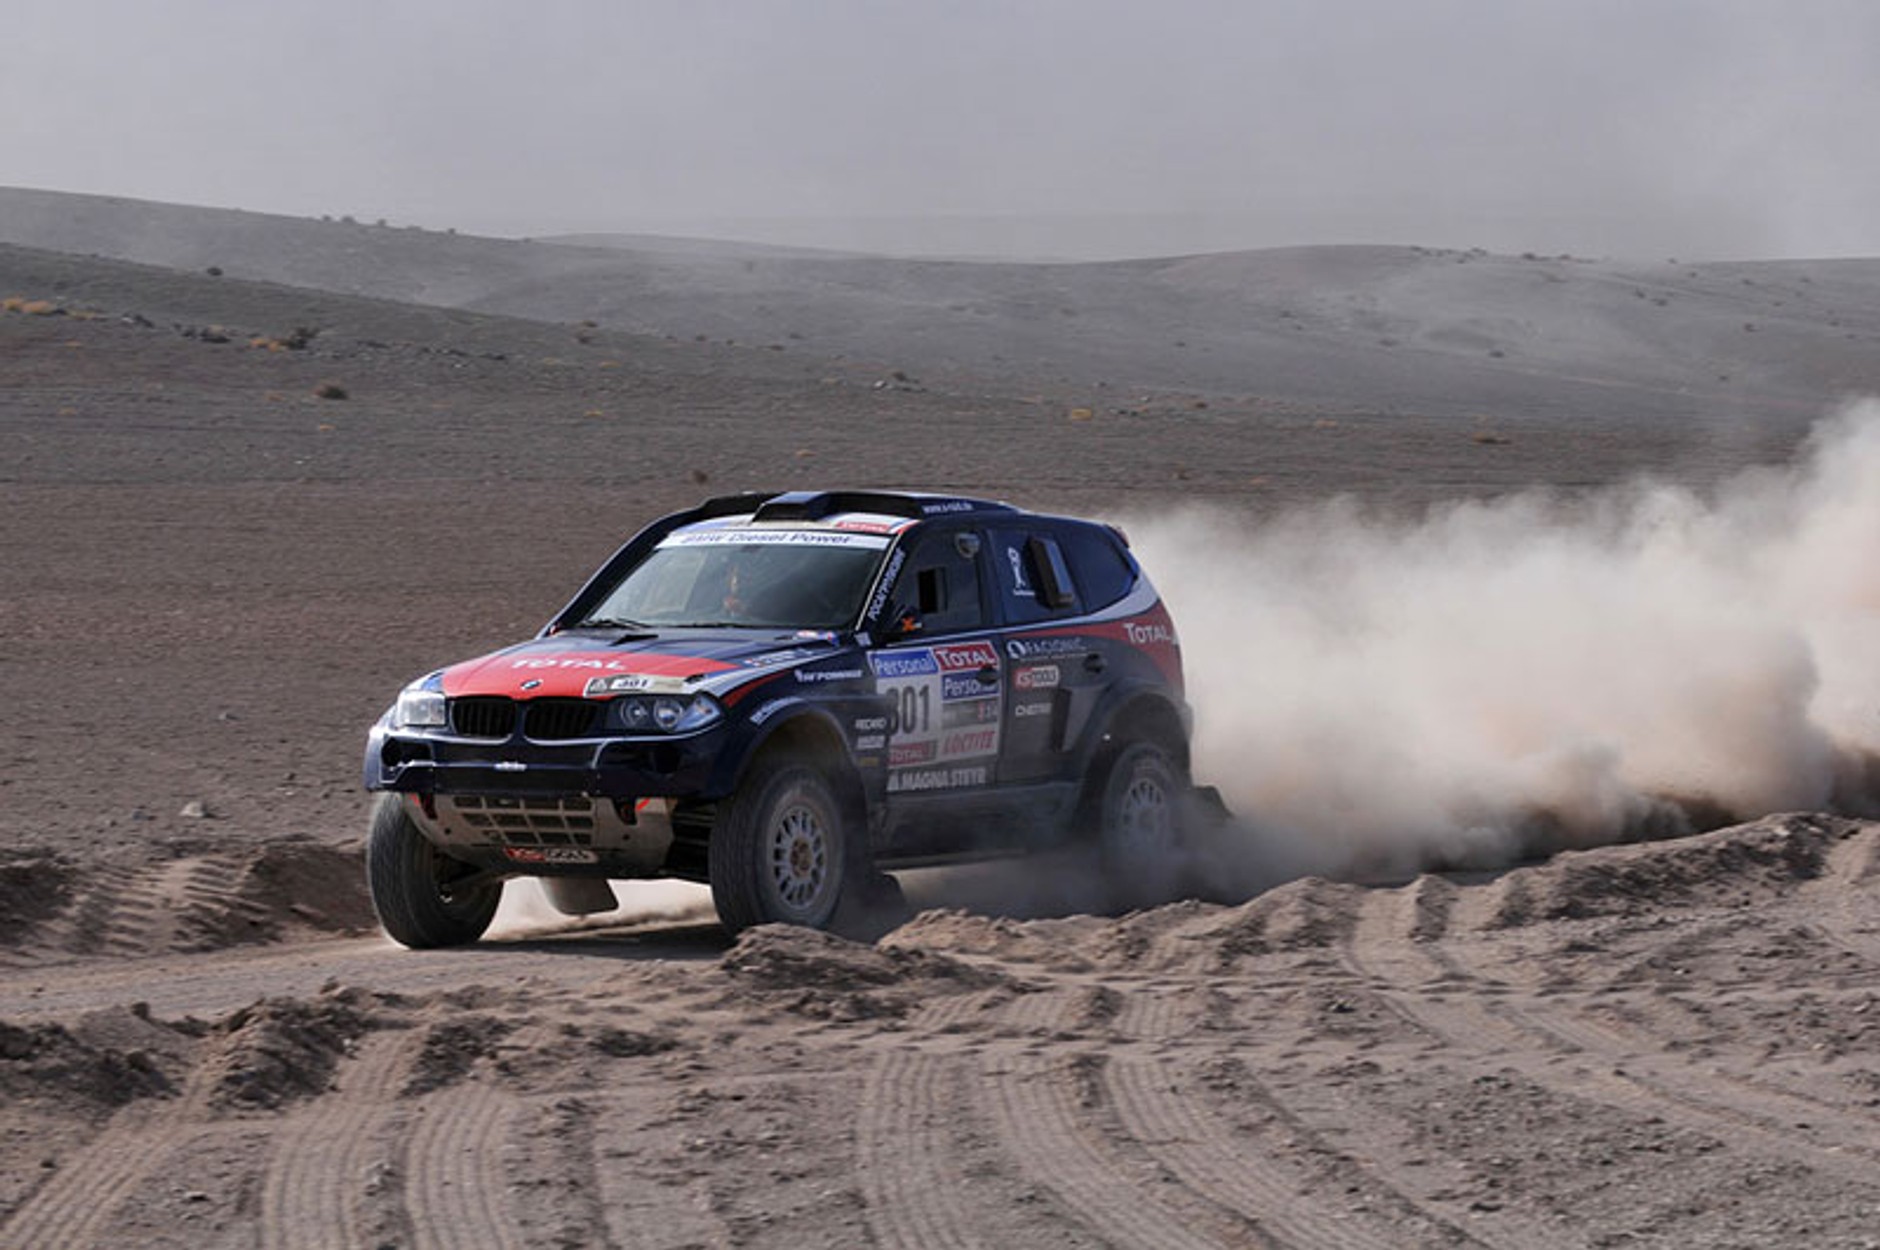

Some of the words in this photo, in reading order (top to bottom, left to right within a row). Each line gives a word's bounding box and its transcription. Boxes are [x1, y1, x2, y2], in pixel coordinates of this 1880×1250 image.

[729, 532, 785, 543] Diesel
[789, 533, 851, 545] Power
[1123, 622, 1172, 644] TOTAL
[512, 657, 626, 671] TOTAL
[874, 653, 937, 676] Personal
[938, 648, 996, 667] TOTAL
[902, 769, 950, 791] MAGNA
